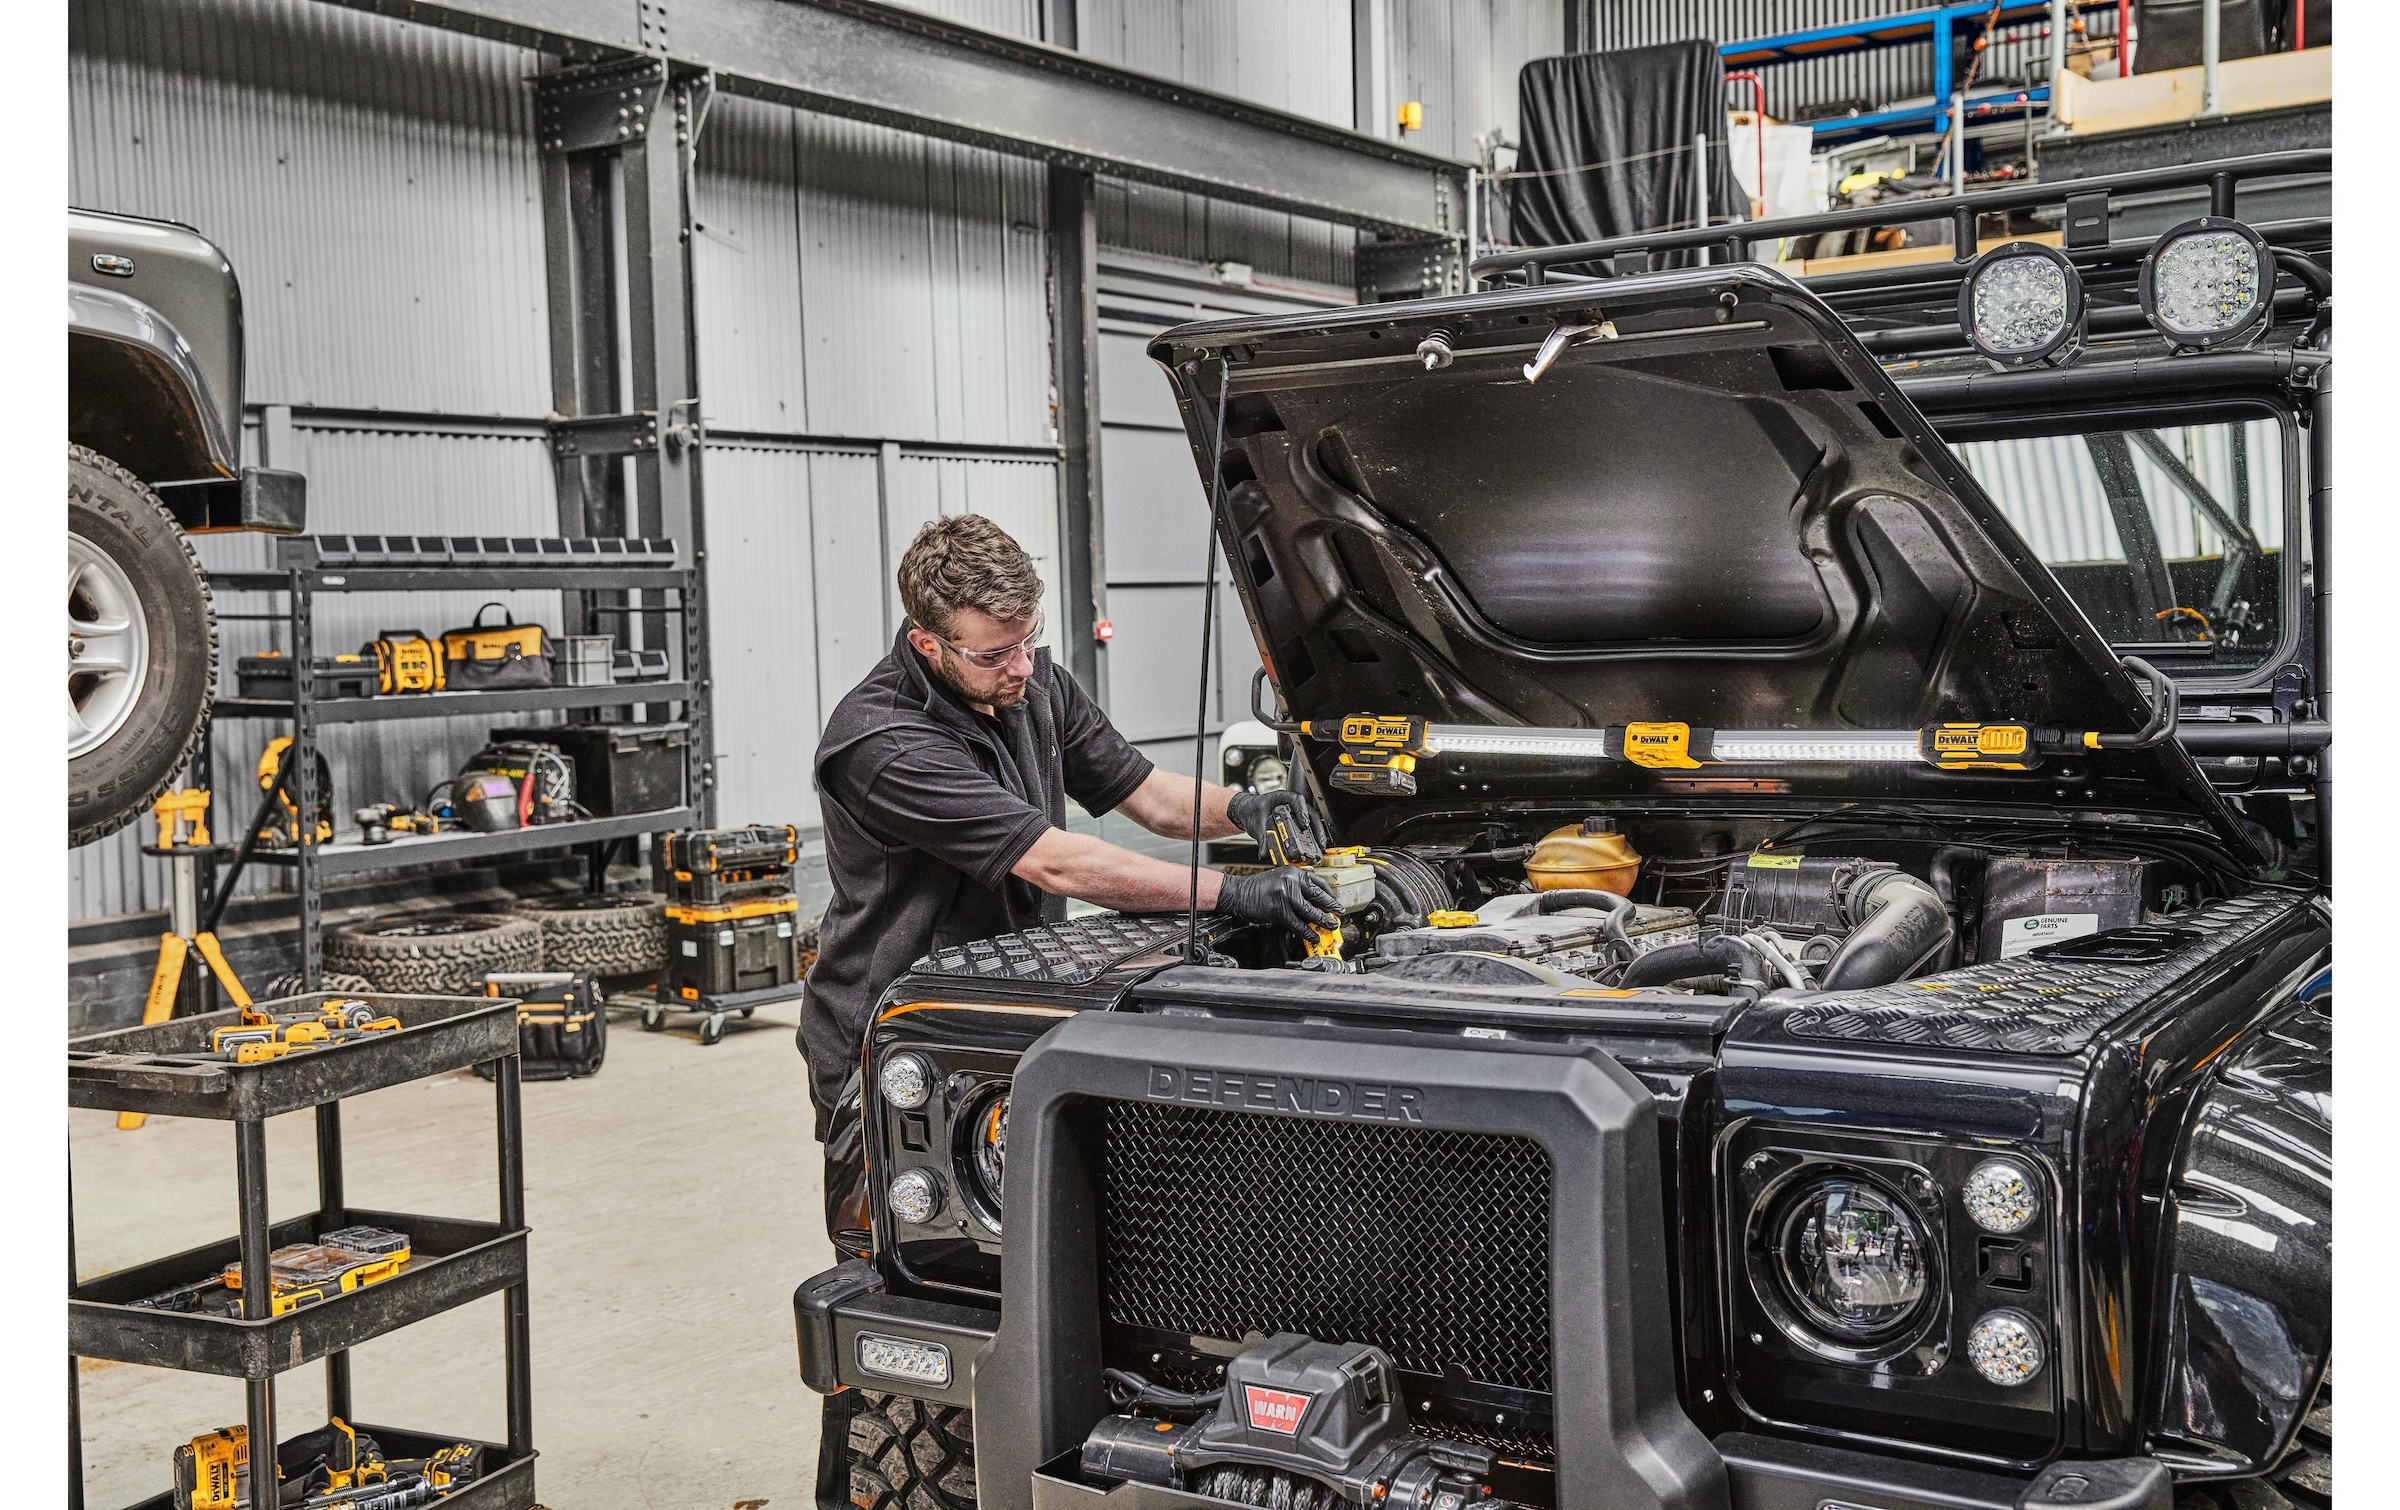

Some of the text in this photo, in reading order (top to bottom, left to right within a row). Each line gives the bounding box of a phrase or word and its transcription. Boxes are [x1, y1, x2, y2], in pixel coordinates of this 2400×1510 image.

[1376, 727, 1407, 735] DEWALT
[1640, 735, 1669, 744] DEWALT
[1938, 735, 1979, 745] DEWALT
[1147, 1065, 1425, 1123] DEFENDER
[1253, 1399, 1297, 1422] WARN
[211, 1464, 220, 1502] DEWALT
